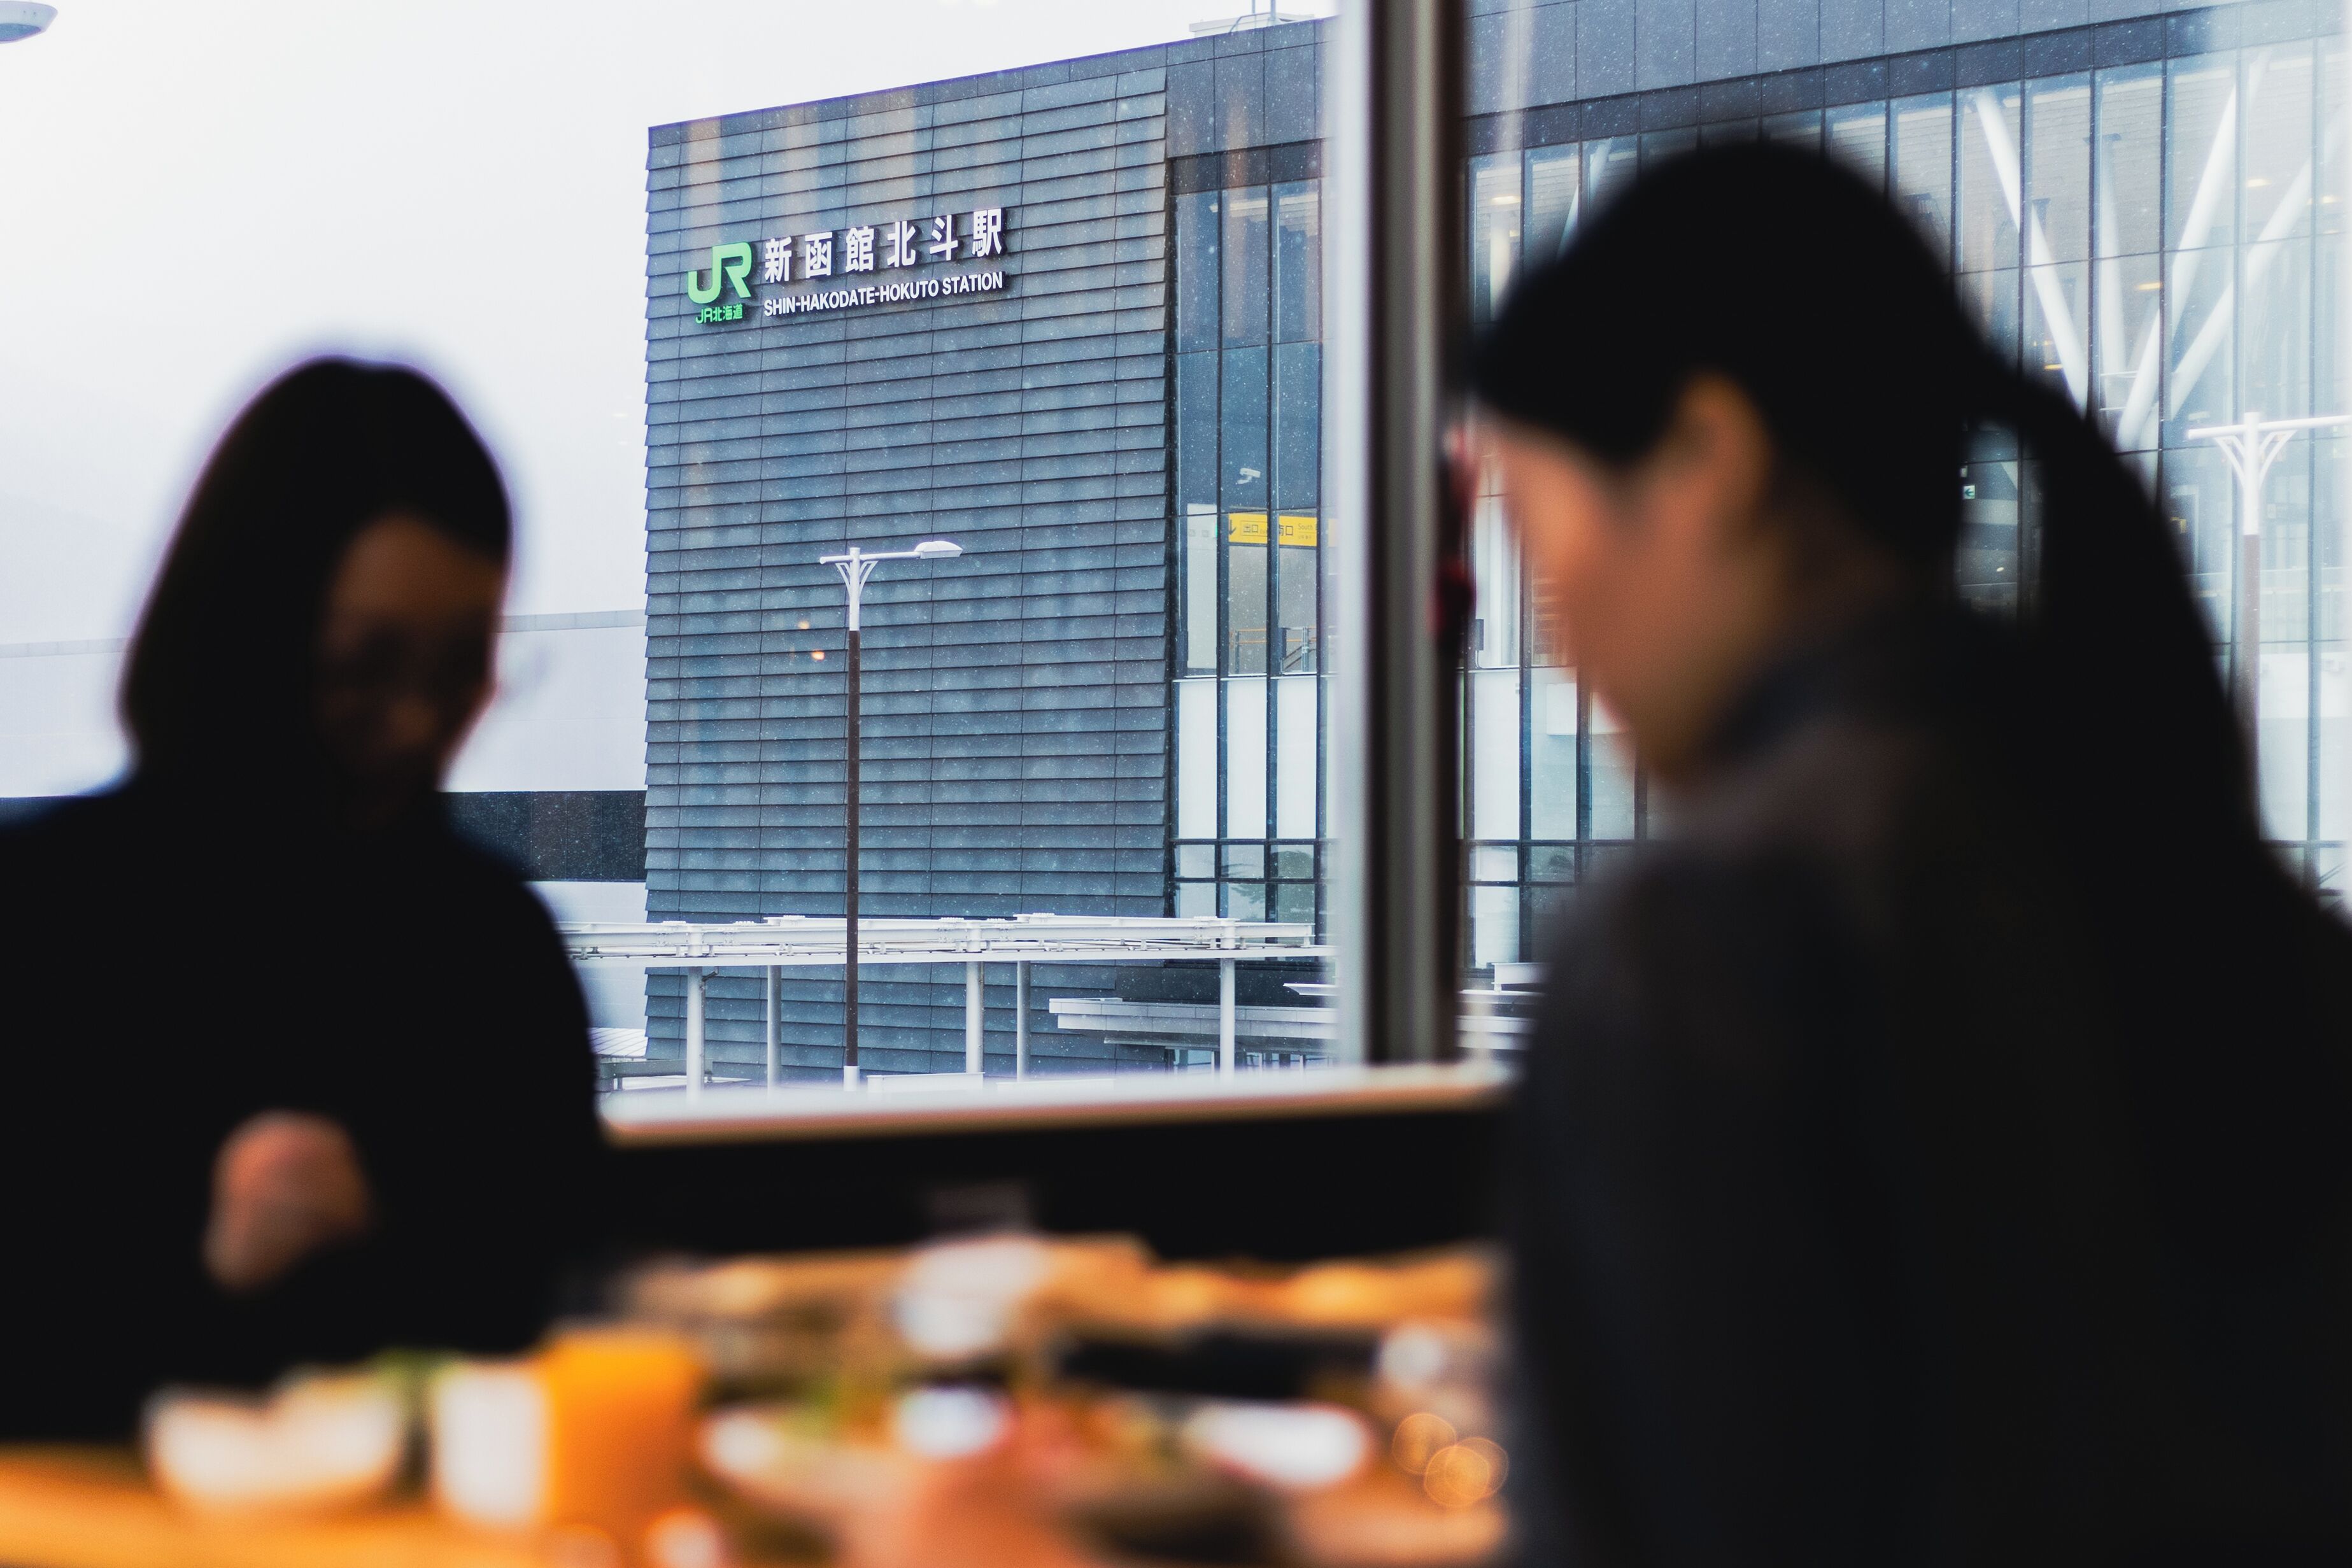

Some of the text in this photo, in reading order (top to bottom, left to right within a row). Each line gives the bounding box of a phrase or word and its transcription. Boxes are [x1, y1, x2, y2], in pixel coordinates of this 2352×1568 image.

[688, 241, 752, 304] JR
[764, 208, 1002, 284] 新函館北斗駅
[695, 303, 744, 324] JR北海道
[764, 271, 1003, 316] SHIN-HAKODATE-HOKUTO STATION
